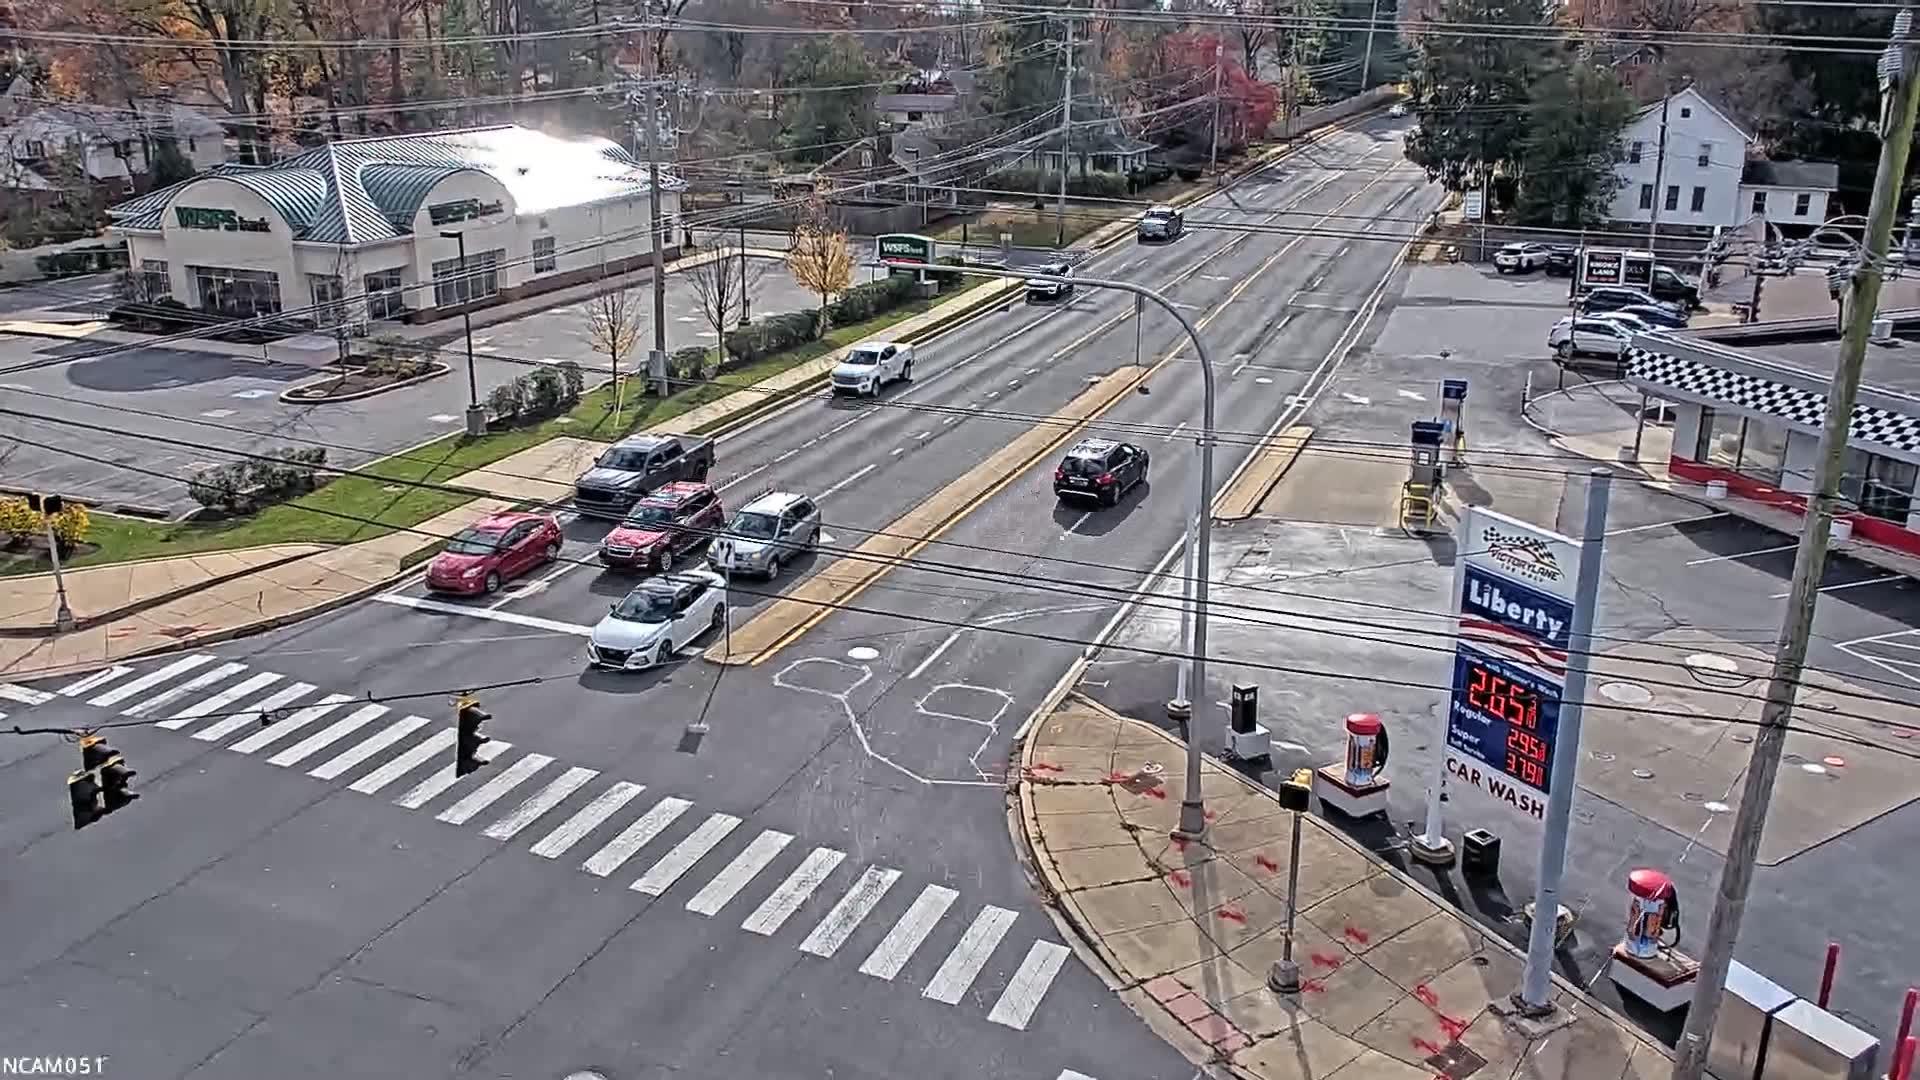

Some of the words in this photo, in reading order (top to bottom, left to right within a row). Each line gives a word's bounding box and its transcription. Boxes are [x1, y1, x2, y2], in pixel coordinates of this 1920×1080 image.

[882, 241, 910, 253] WSFS
[1592, 268, 1616, 276] LAND
[1469, 579, 1564, 640] Liberty
[1453, 699, 1493, 727] Regular
[1450, 724, 1481, 744] Super
[1446, 757, 1481, 788] CAR
[1488, 777, 1545, 820] WASH
